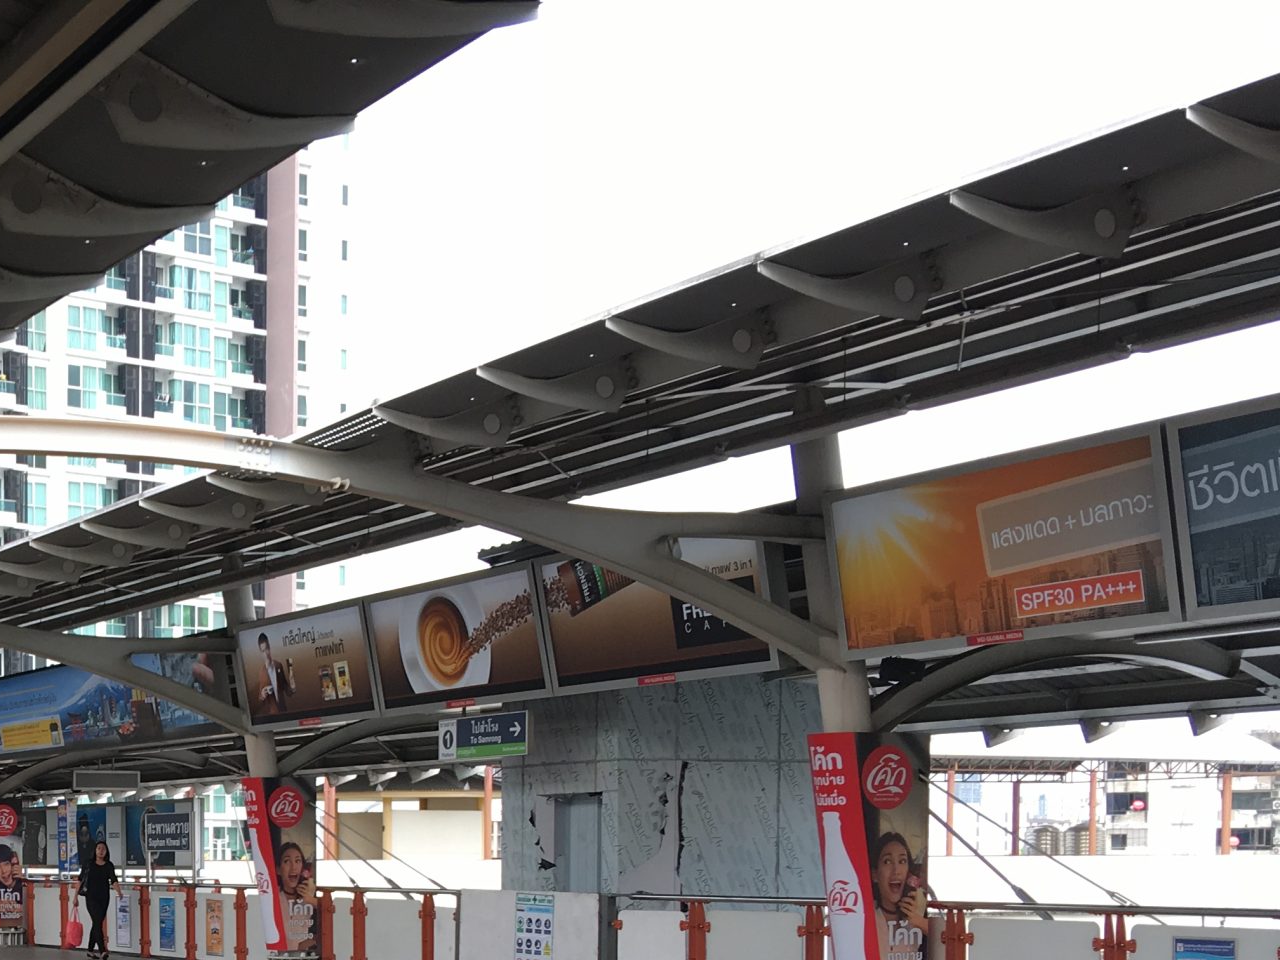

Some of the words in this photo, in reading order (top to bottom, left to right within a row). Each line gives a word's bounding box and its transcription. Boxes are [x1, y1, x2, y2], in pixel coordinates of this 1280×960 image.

[991, 516, 1060, 550] แสงแดด
[1080, 494, 1155, 528] มลภาวะ
[1021, 587, 1074, 611] SPF30
[1081, 580, 1138, 603] PA+++
[887, 920, 923, 946] โค้ก
